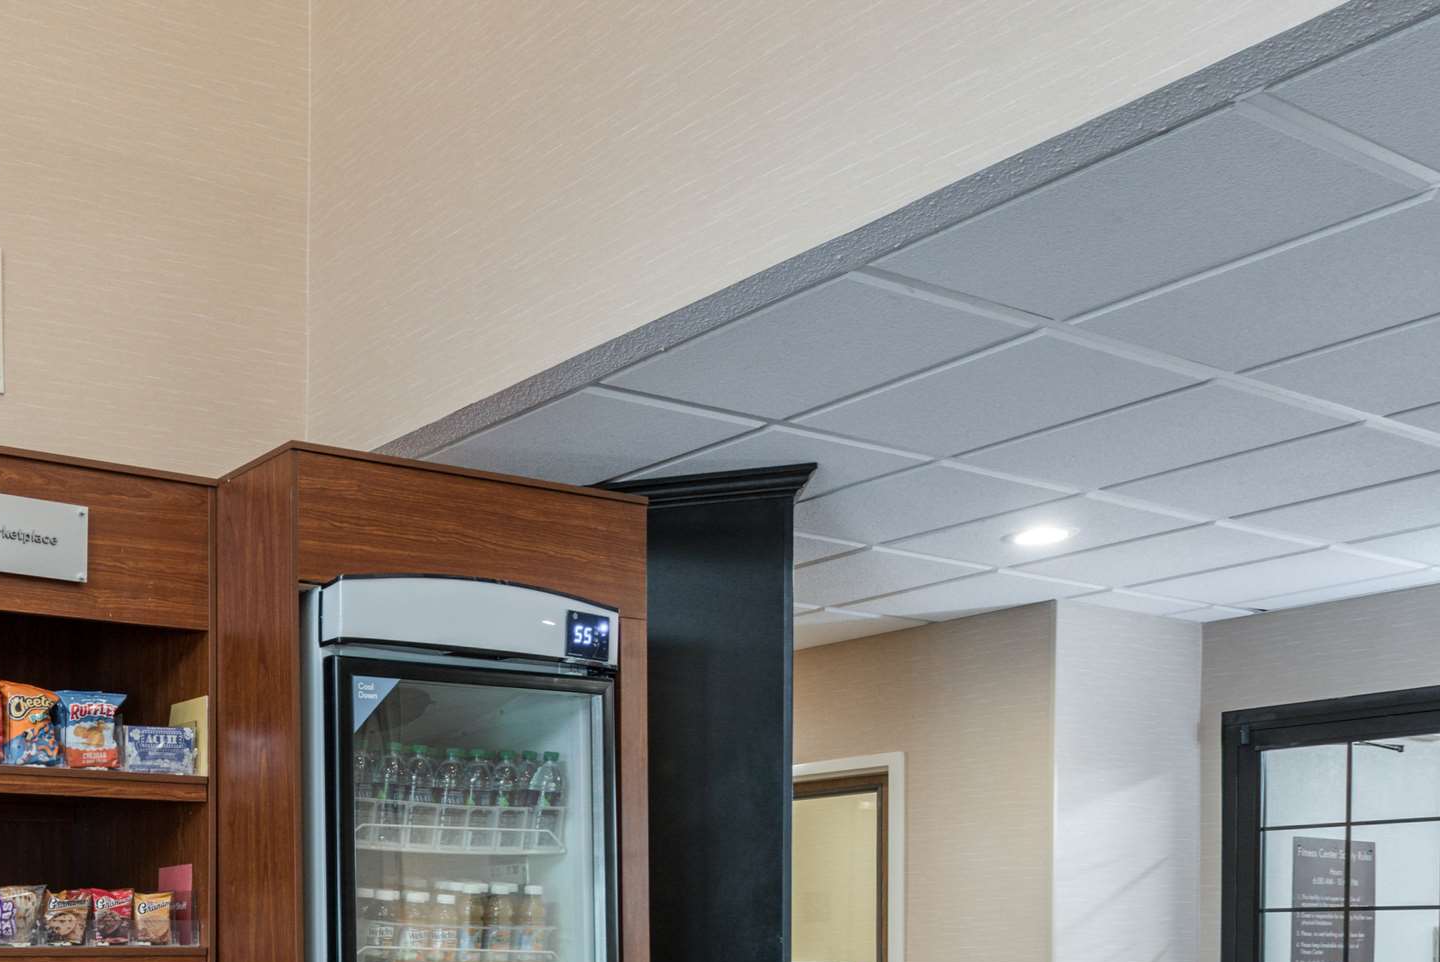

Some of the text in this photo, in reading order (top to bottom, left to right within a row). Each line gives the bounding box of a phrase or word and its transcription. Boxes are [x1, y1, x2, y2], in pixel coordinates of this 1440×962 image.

[573, 624, 593, 645] 55
[357, 681, 374, 691] Cool
[357, 690, 378, 700] Down
